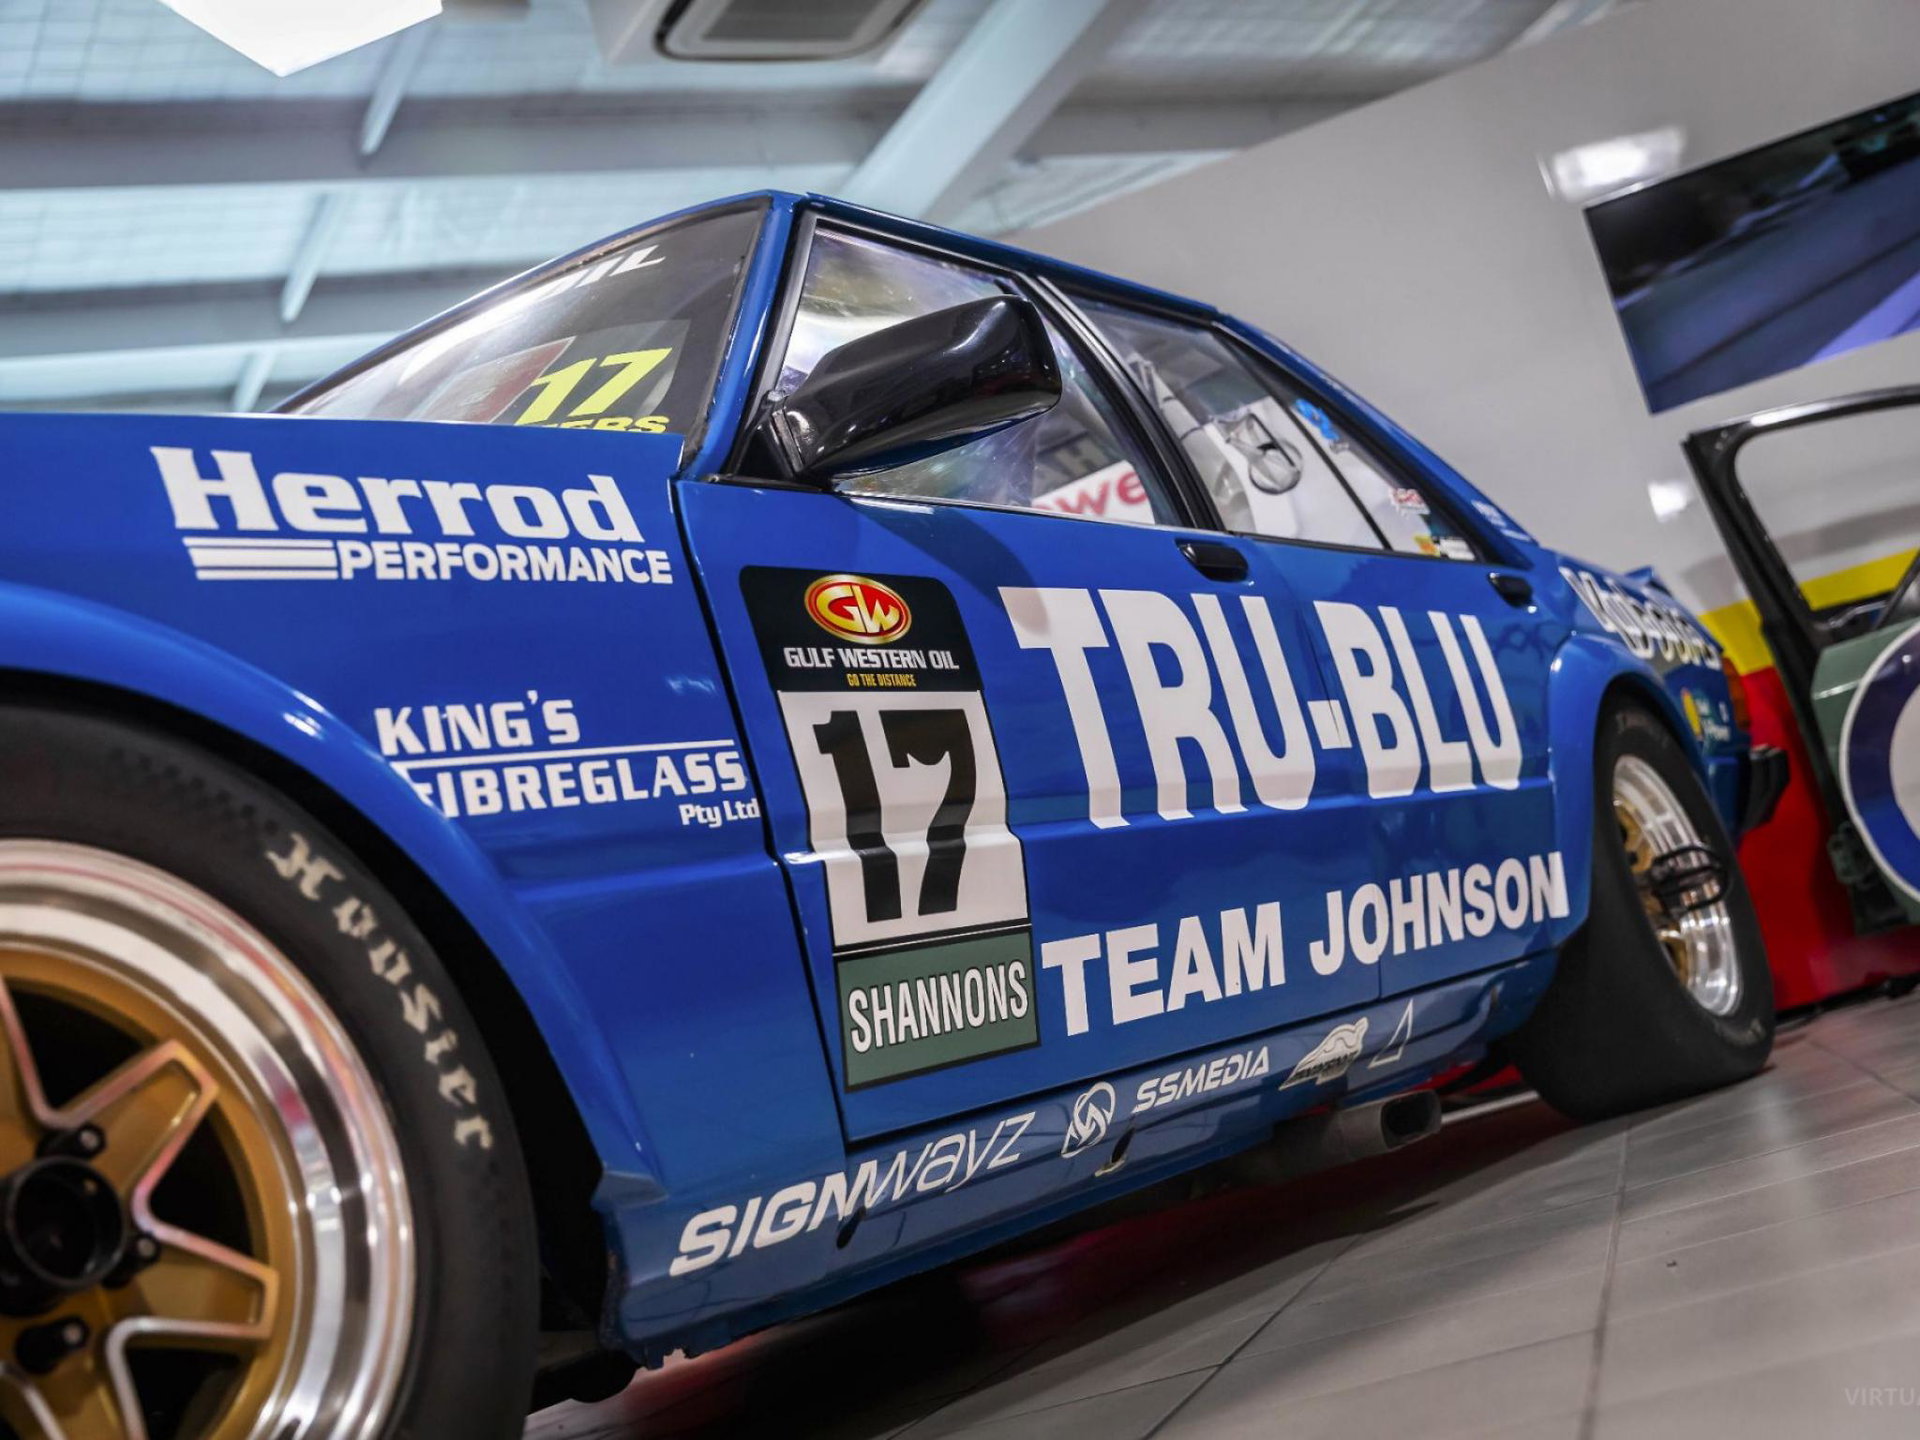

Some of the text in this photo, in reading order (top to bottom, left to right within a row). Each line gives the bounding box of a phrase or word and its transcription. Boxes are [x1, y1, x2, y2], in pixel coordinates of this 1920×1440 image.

[514, 347, 672, 426] 17
[150, 447, 645, 543] Herrod
[338, 540, 672, 584] PERFORMANCE
[816, 585, 900, 633] GW
[783, 647, 960, 670] GULF WESTERN OIL
[847, 673, 917, 687] GO THE DISTANCE
[374, 690, 580, 756] KING'S
[997, 587, 1522, 829] TRU-BLU
[679, 798, 761, 828] Pty Ltd
[812, 709, 976, 923] 17
[1041, 851, 1569, 1036] TEAM JOHNSON
[849, 959, 1028, 1053] SHANNONS
[1131, 1046, 1270, 1114] SSMEDIA
